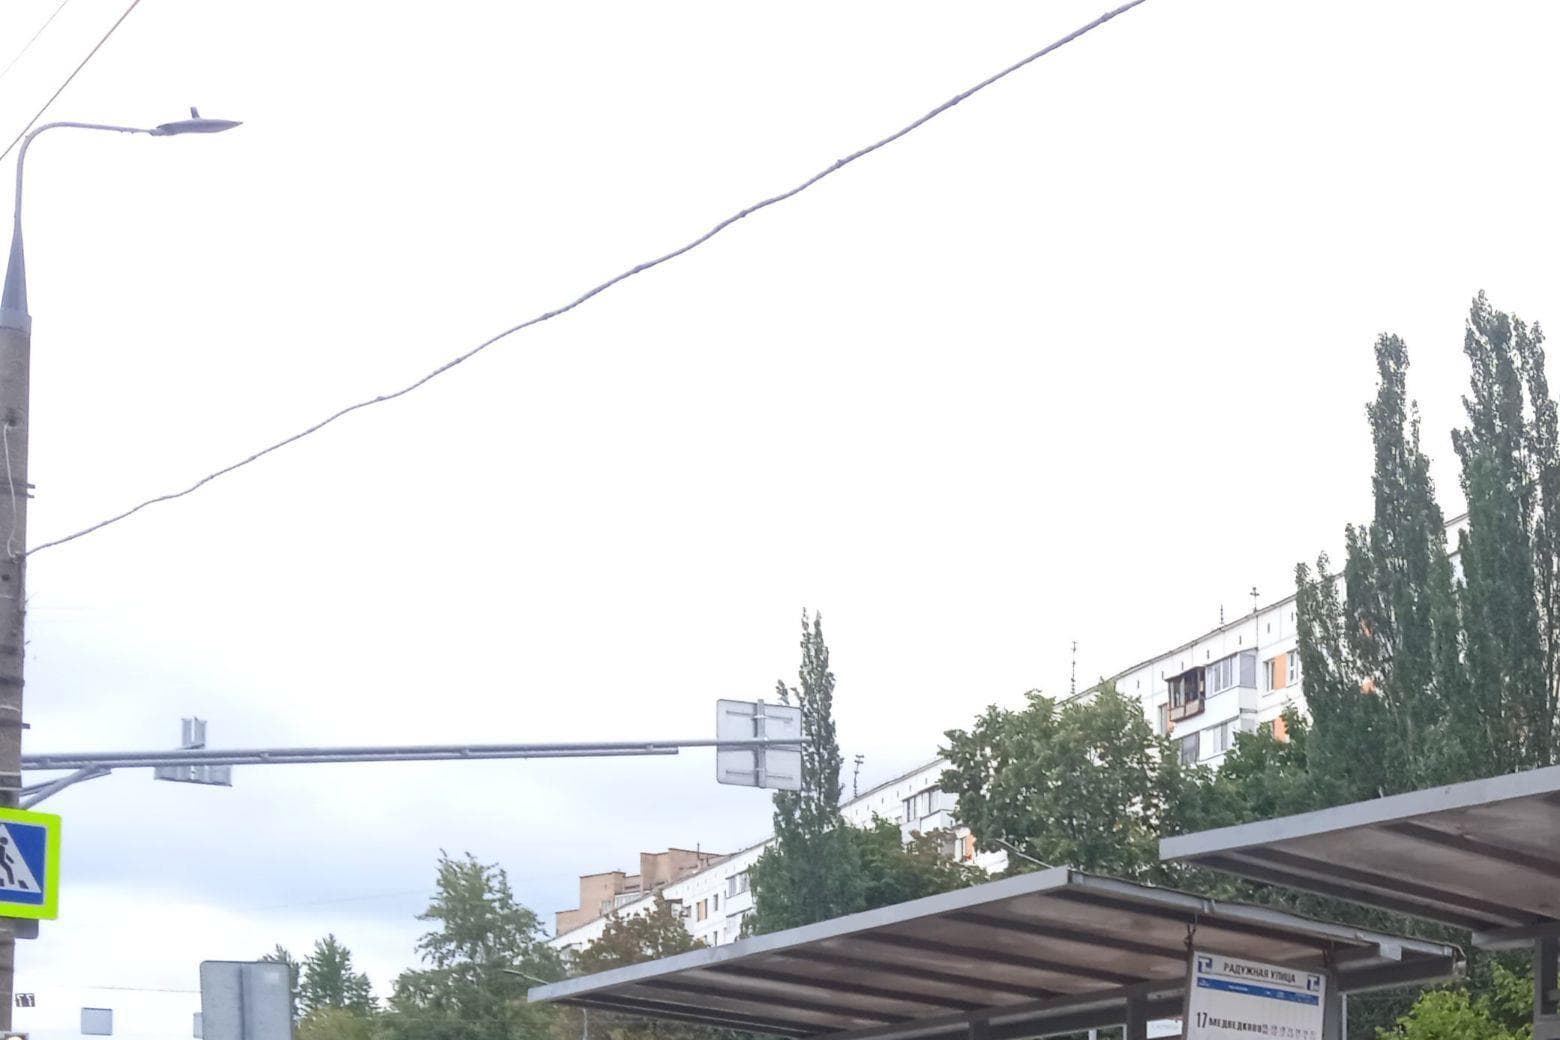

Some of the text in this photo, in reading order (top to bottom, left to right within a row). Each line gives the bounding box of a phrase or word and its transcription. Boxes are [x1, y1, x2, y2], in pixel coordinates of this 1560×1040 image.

[1223, 962, 1296, 983] РАДУЖНАЯ УЛИЦА
[1197, 1012, 1208, 1028] 17
